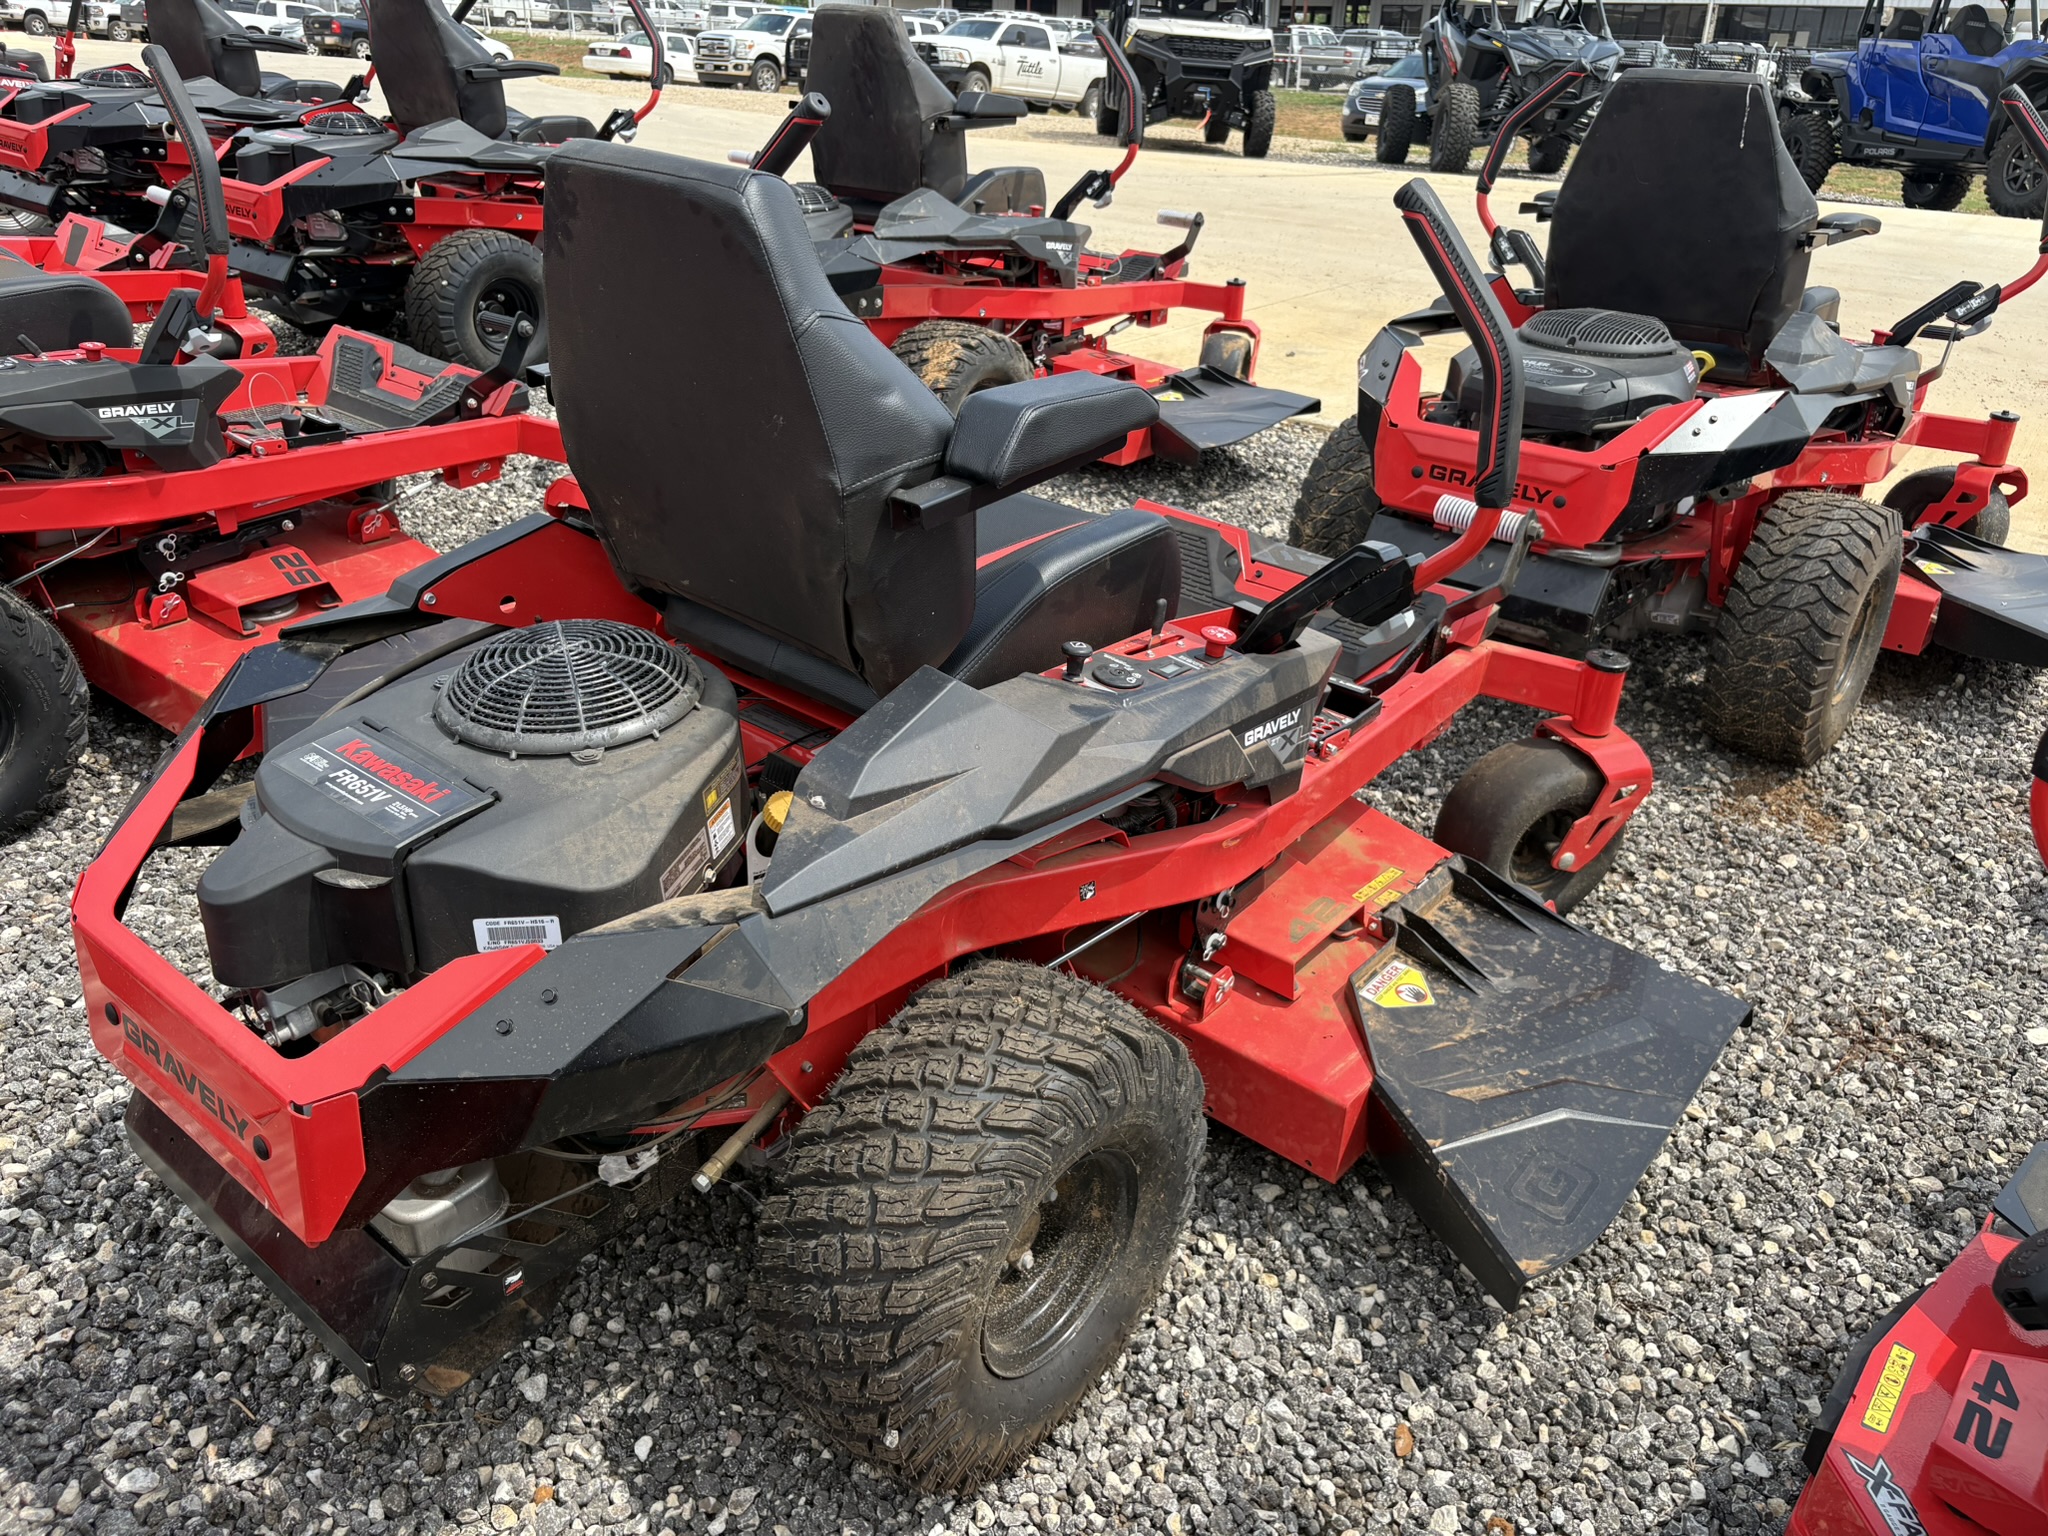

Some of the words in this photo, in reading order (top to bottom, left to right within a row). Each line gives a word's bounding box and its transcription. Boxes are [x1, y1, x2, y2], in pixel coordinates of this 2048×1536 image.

[1017, 60, 1043, 76] Tuttle
[1863, 147, 1896, 156] POLARIS
[1045, 241, 1073, 251] GRAVELY
[98, 402, 175, 419] GRAVELY
[270, 552, 323, 587] 52
[1244, 707, 1302, 748] GRAVELY
[328, 768, 393, 803] FR651V
[335, 738, 452, 804] Kawasaki
[1289, 896, 1348, 944] 42
[1366, 965, 1403, 996] DANGER
[121, 1012, 249, 1141] GRAVELY
[1952, 1359, 2021, 1460] 42
